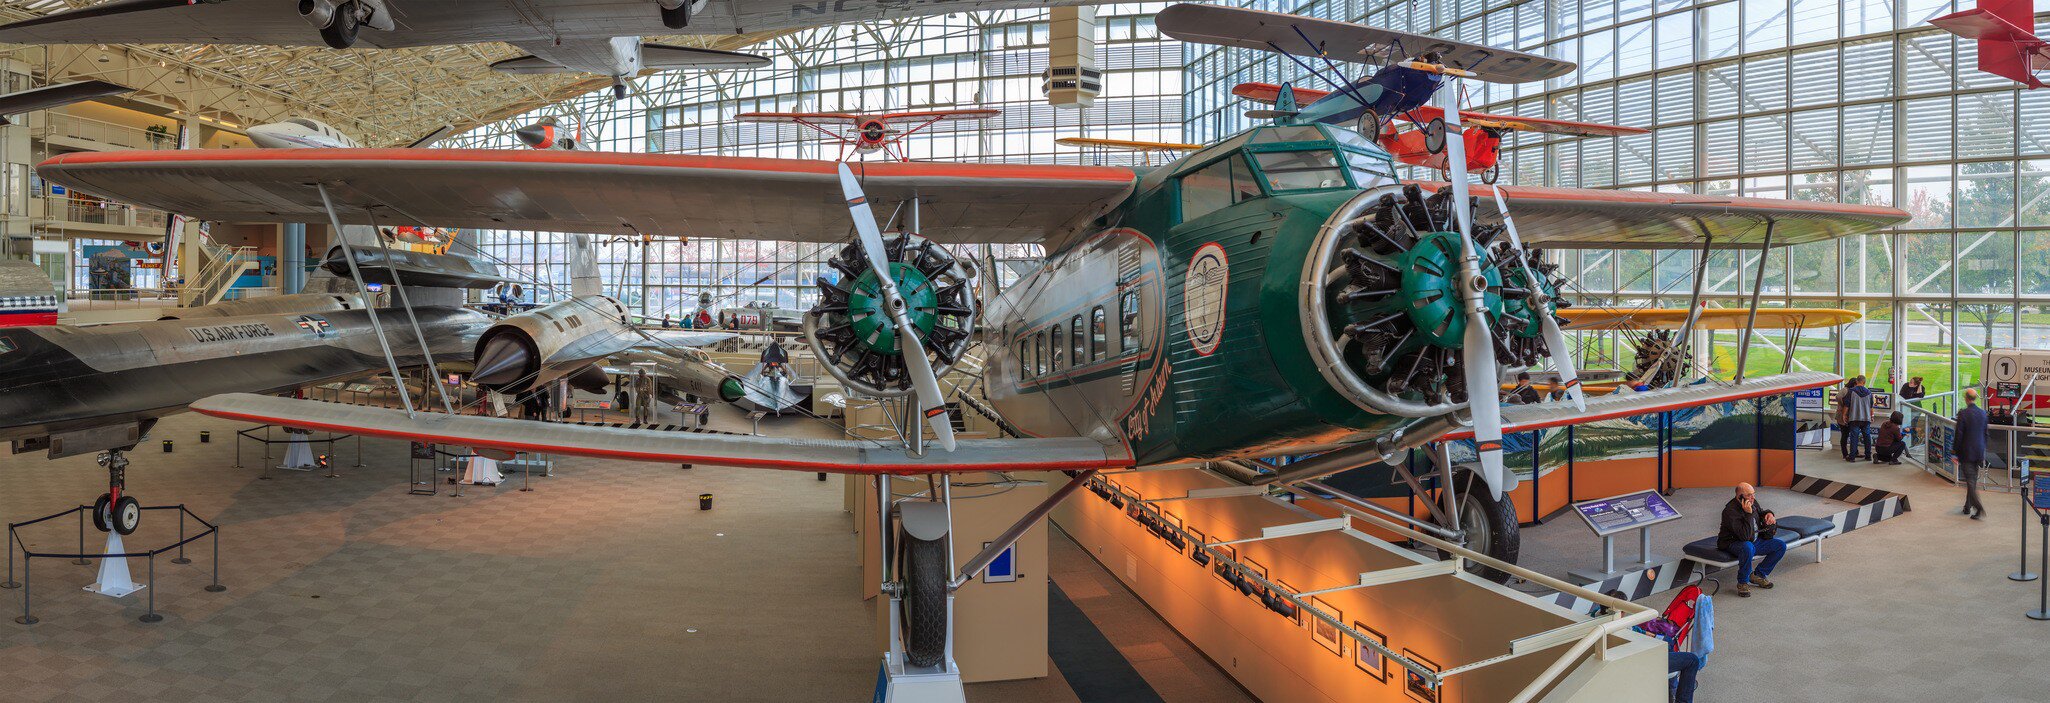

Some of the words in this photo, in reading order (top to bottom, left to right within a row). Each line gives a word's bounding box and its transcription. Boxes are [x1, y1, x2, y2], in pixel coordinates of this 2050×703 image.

[740, 315, 758, 325] 079
[234, 323, 274, 339] FORCE
[2001, 362, 2009, 376] 1
[1142, 397, 1149, 435] of
[1150, 357, 1172, 416] Auburn
